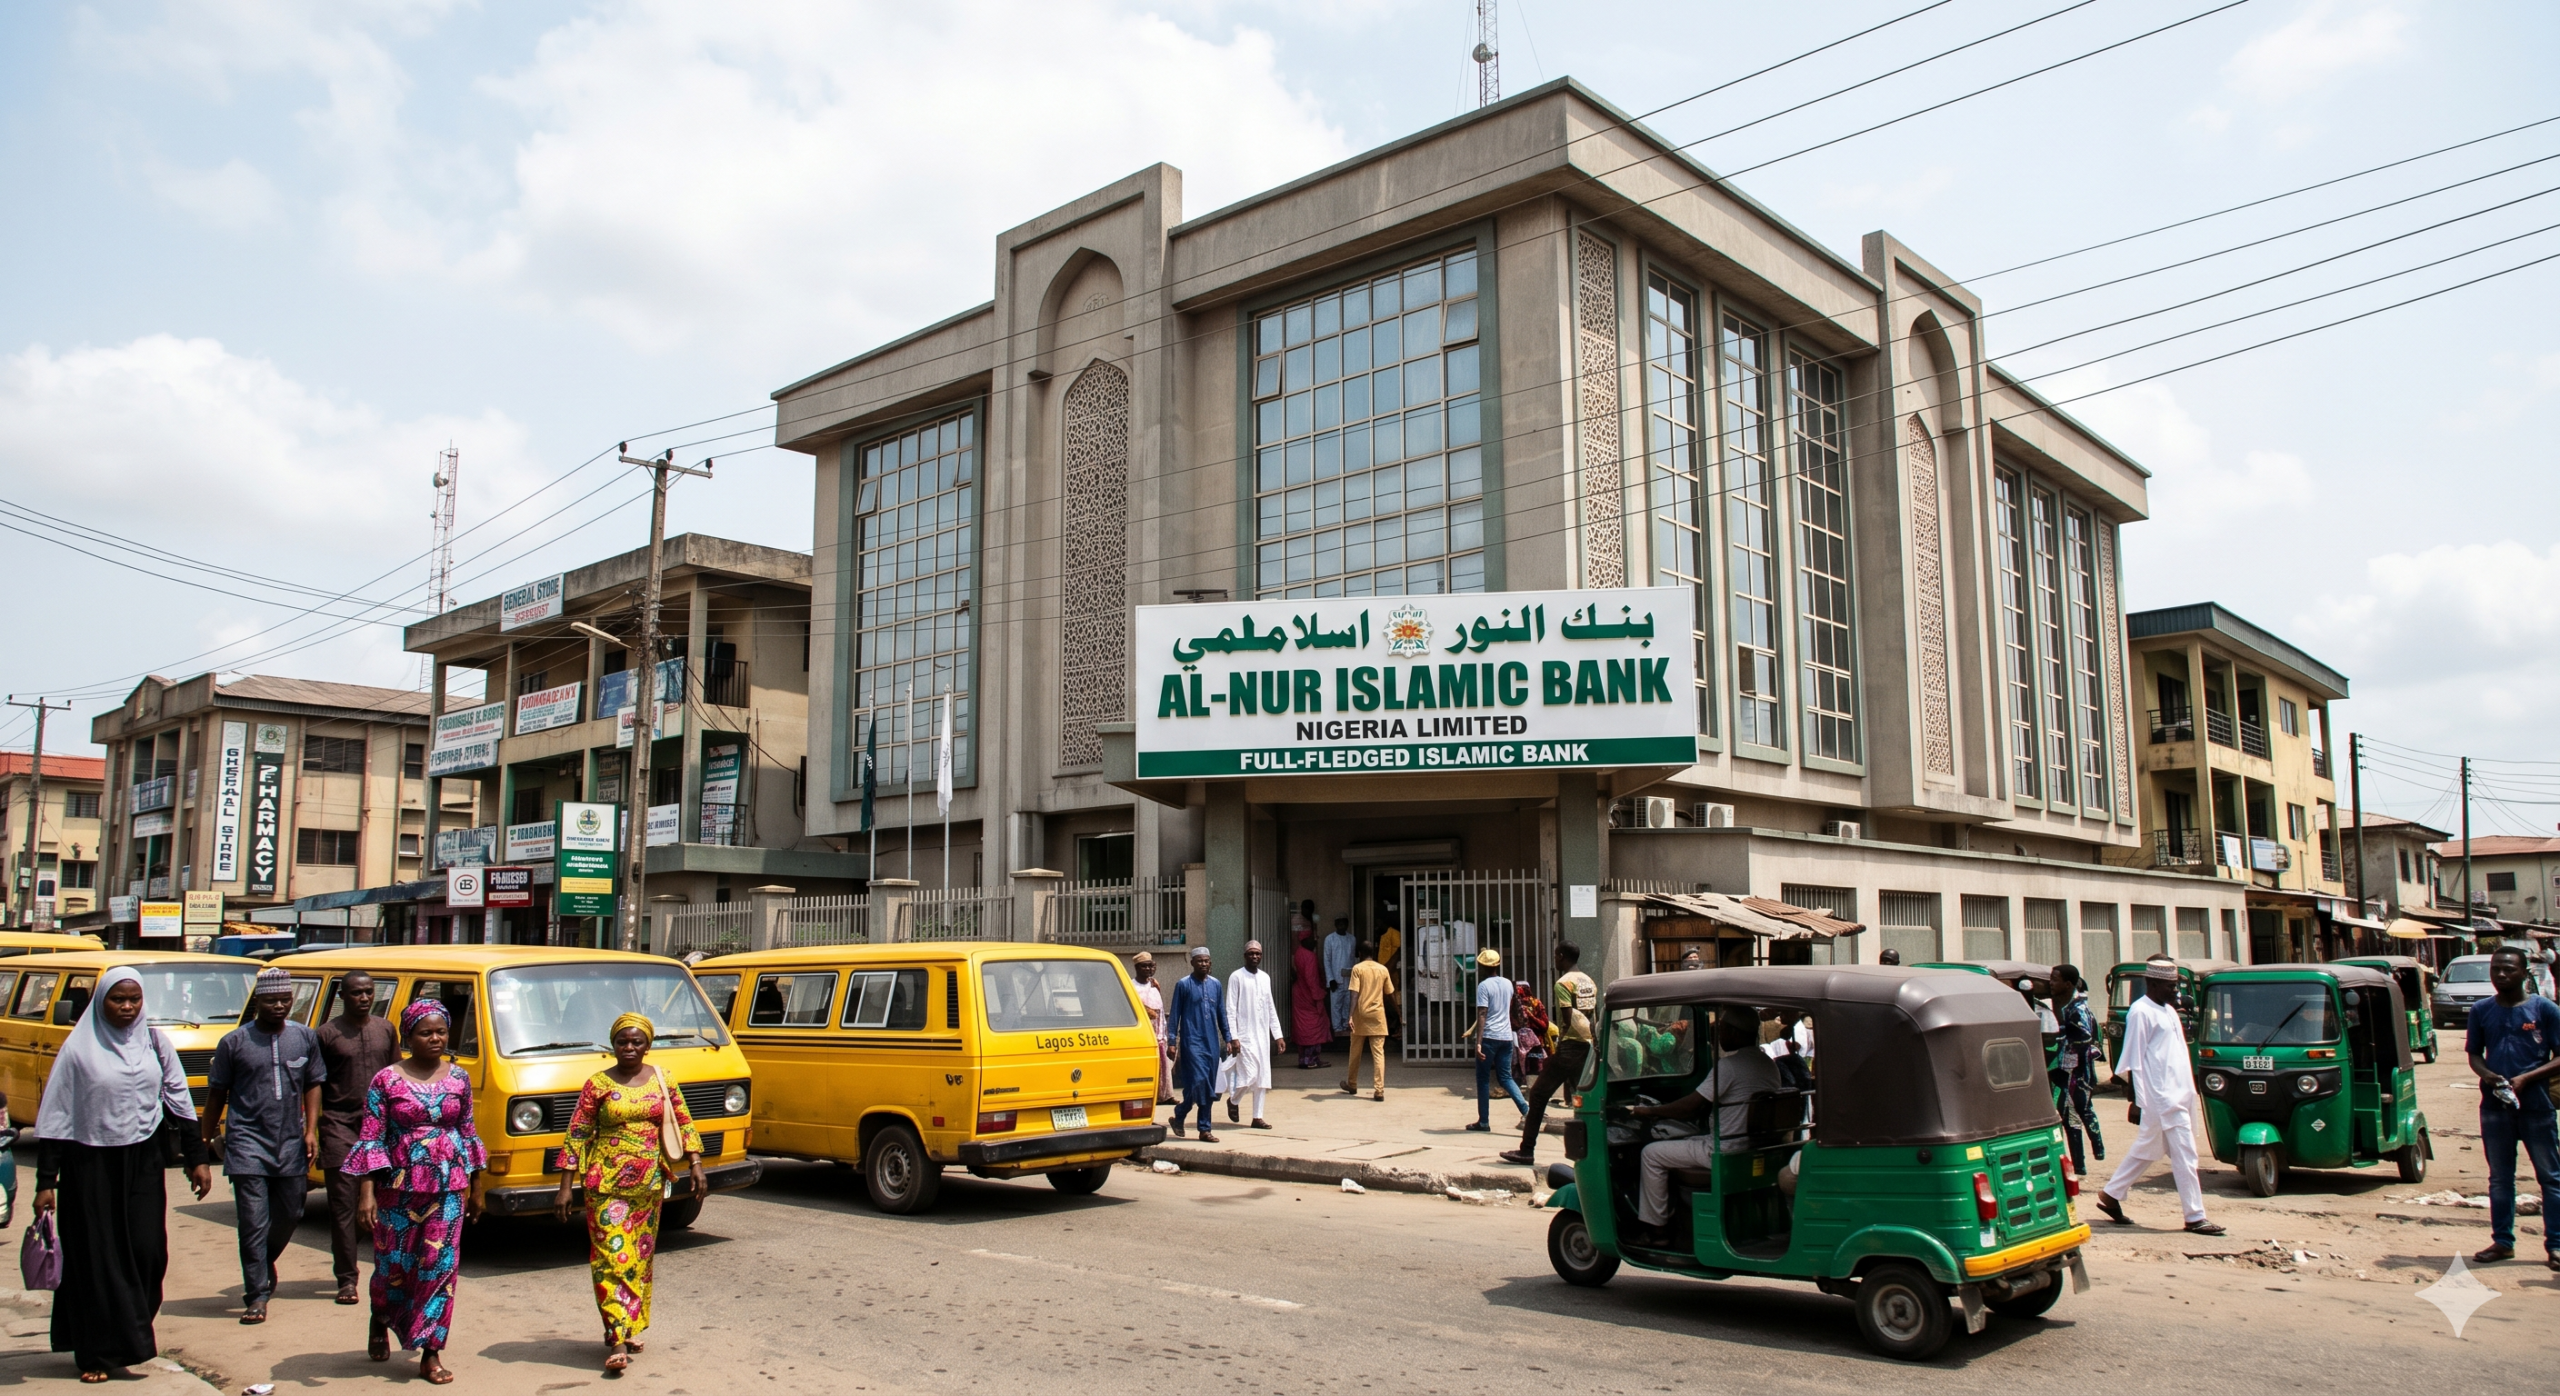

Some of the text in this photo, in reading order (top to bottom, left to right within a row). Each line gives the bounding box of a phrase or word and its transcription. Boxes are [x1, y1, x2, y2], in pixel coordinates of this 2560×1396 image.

[1444, 603, 1545, 654] النور
[1561, 602, 1654, 649] بنك
[1158, 657, 1673, 719] AL-NUR ISLAMIC BANK
[1296, 715, 1528, 741] NIGERIA LIMITED
[1240, 743, 1589, 770] FULL-FLEDGED ISLAMIC BANK
[1035, 1032, 1110, 1053] Lagos State
